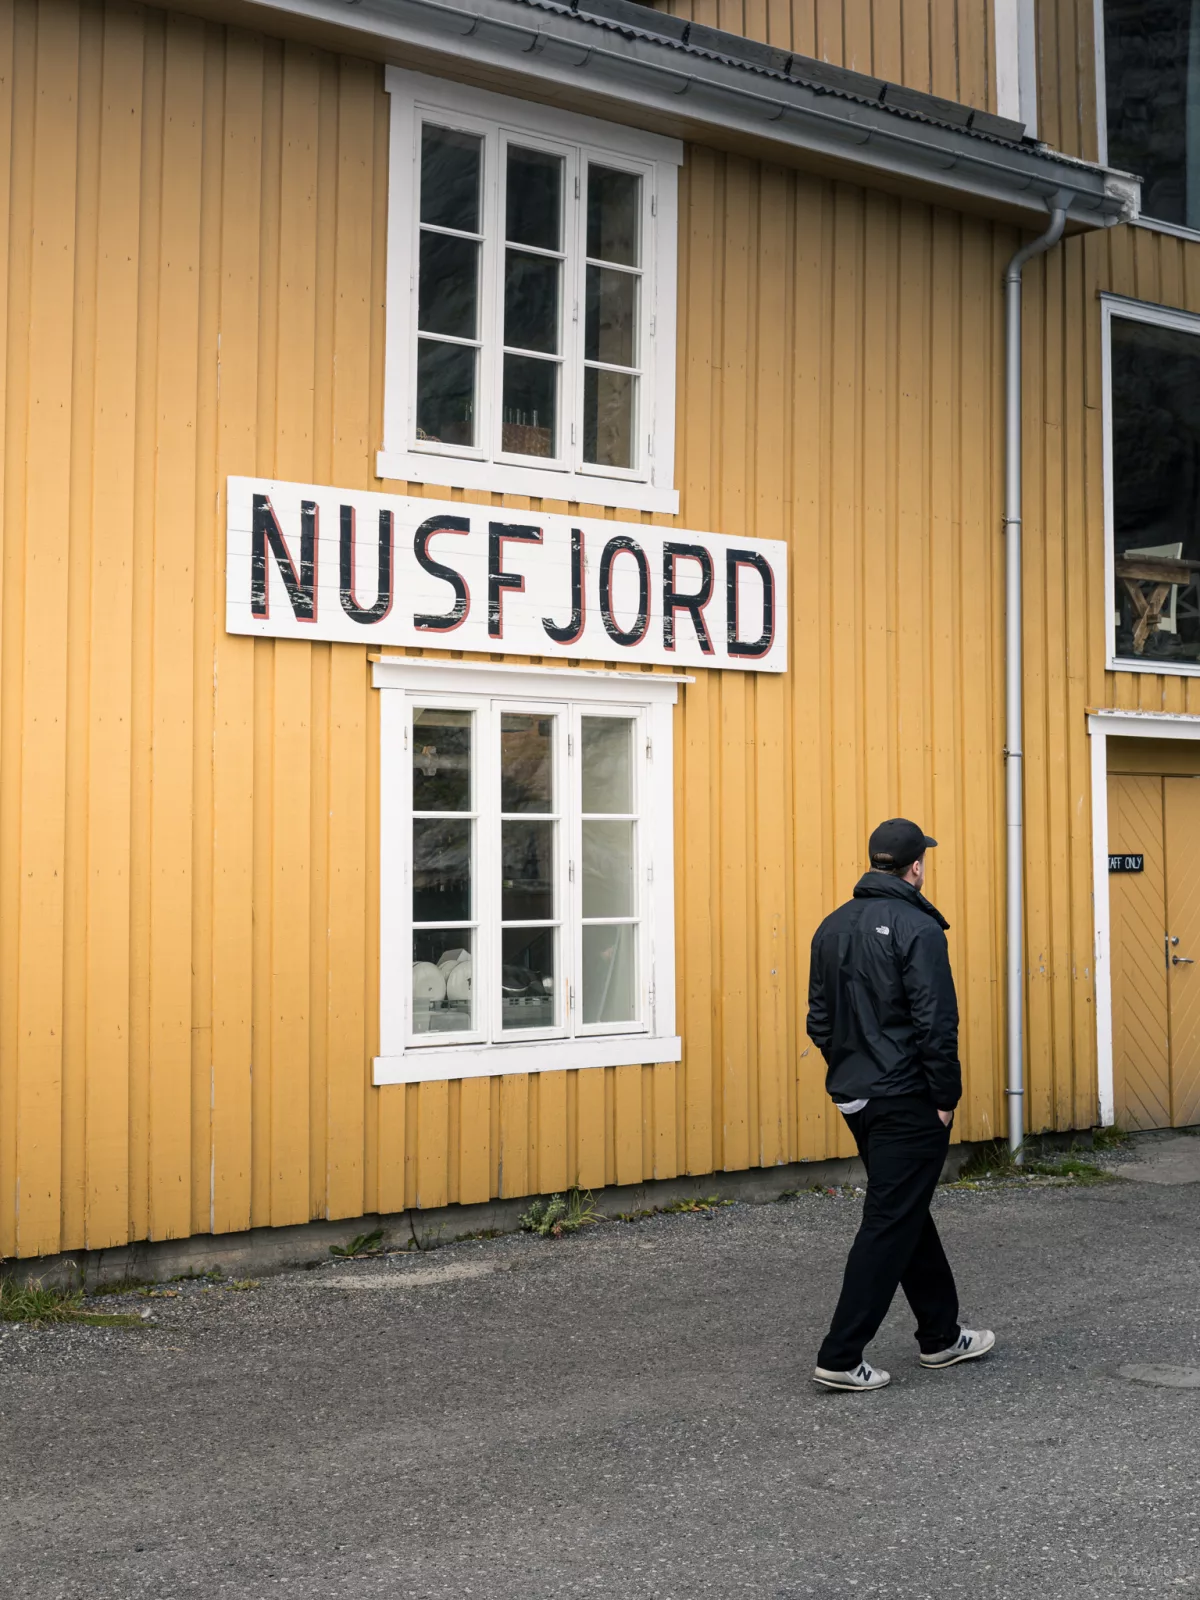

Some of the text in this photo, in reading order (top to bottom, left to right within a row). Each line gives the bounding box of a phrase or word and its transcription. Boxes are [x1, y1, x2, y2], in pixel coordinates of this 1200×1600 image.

[251, 493, 776, 659] NUSFJORD
[1125, 856, 1142, 869] ONLY
[957, 1335, 972, 1350] N
[857, 1365, 872, 1381] N
